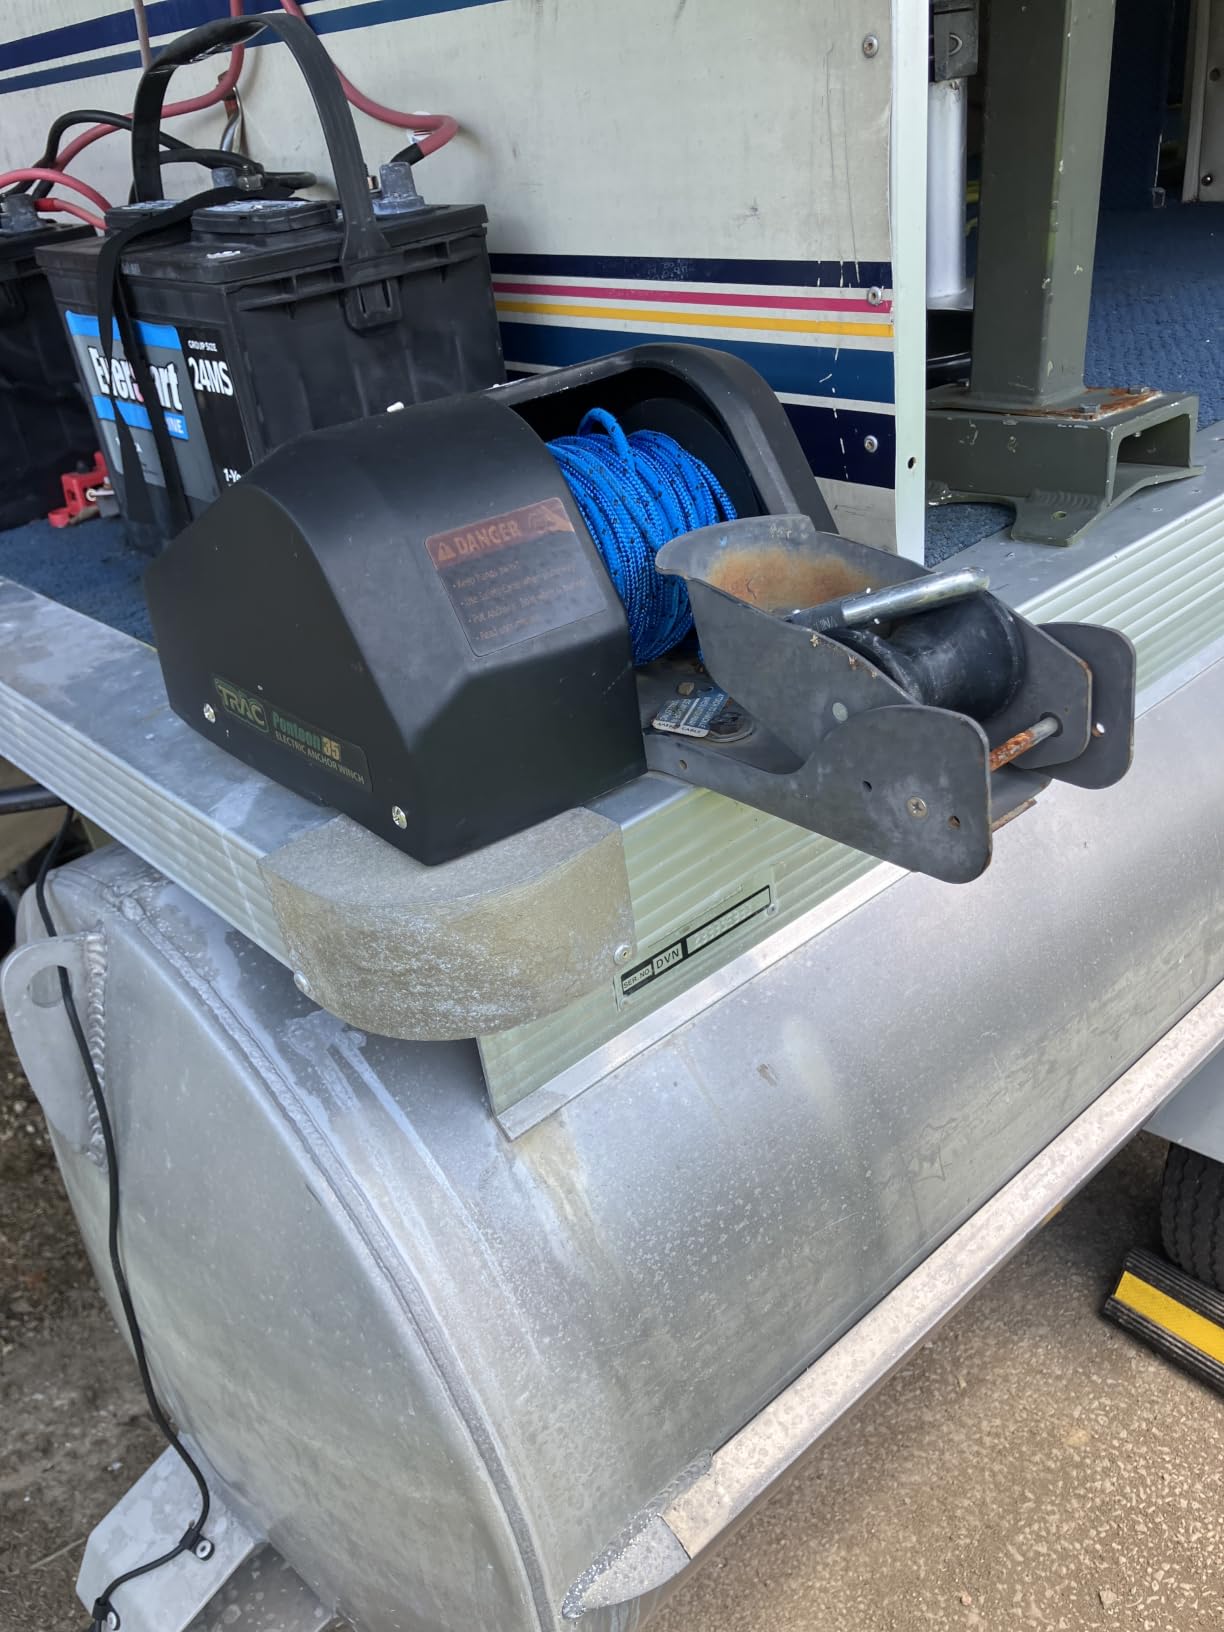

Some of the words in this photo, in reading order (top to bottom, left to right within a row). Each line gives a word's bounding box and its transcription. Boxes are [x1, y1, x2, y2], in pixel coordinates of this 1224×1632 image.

[187, 339, 206, 351] GROUP
[204, 341, 218, 352] SIZE
[187, 356, 234, 397] 24MS
[453, 520, 522, 555] DANGER
[217, 684, 265, 726] TRAC
[272, 710, 320, 752] Pontoon
[320, 734, 342, 761] 35
[274, 730, 306, 755] ELECTRIC
[307, 747, 338, 770] ANCHOR
[337, 763, 365, 785] WINCH
[656, 948, 680, 969] DVN
